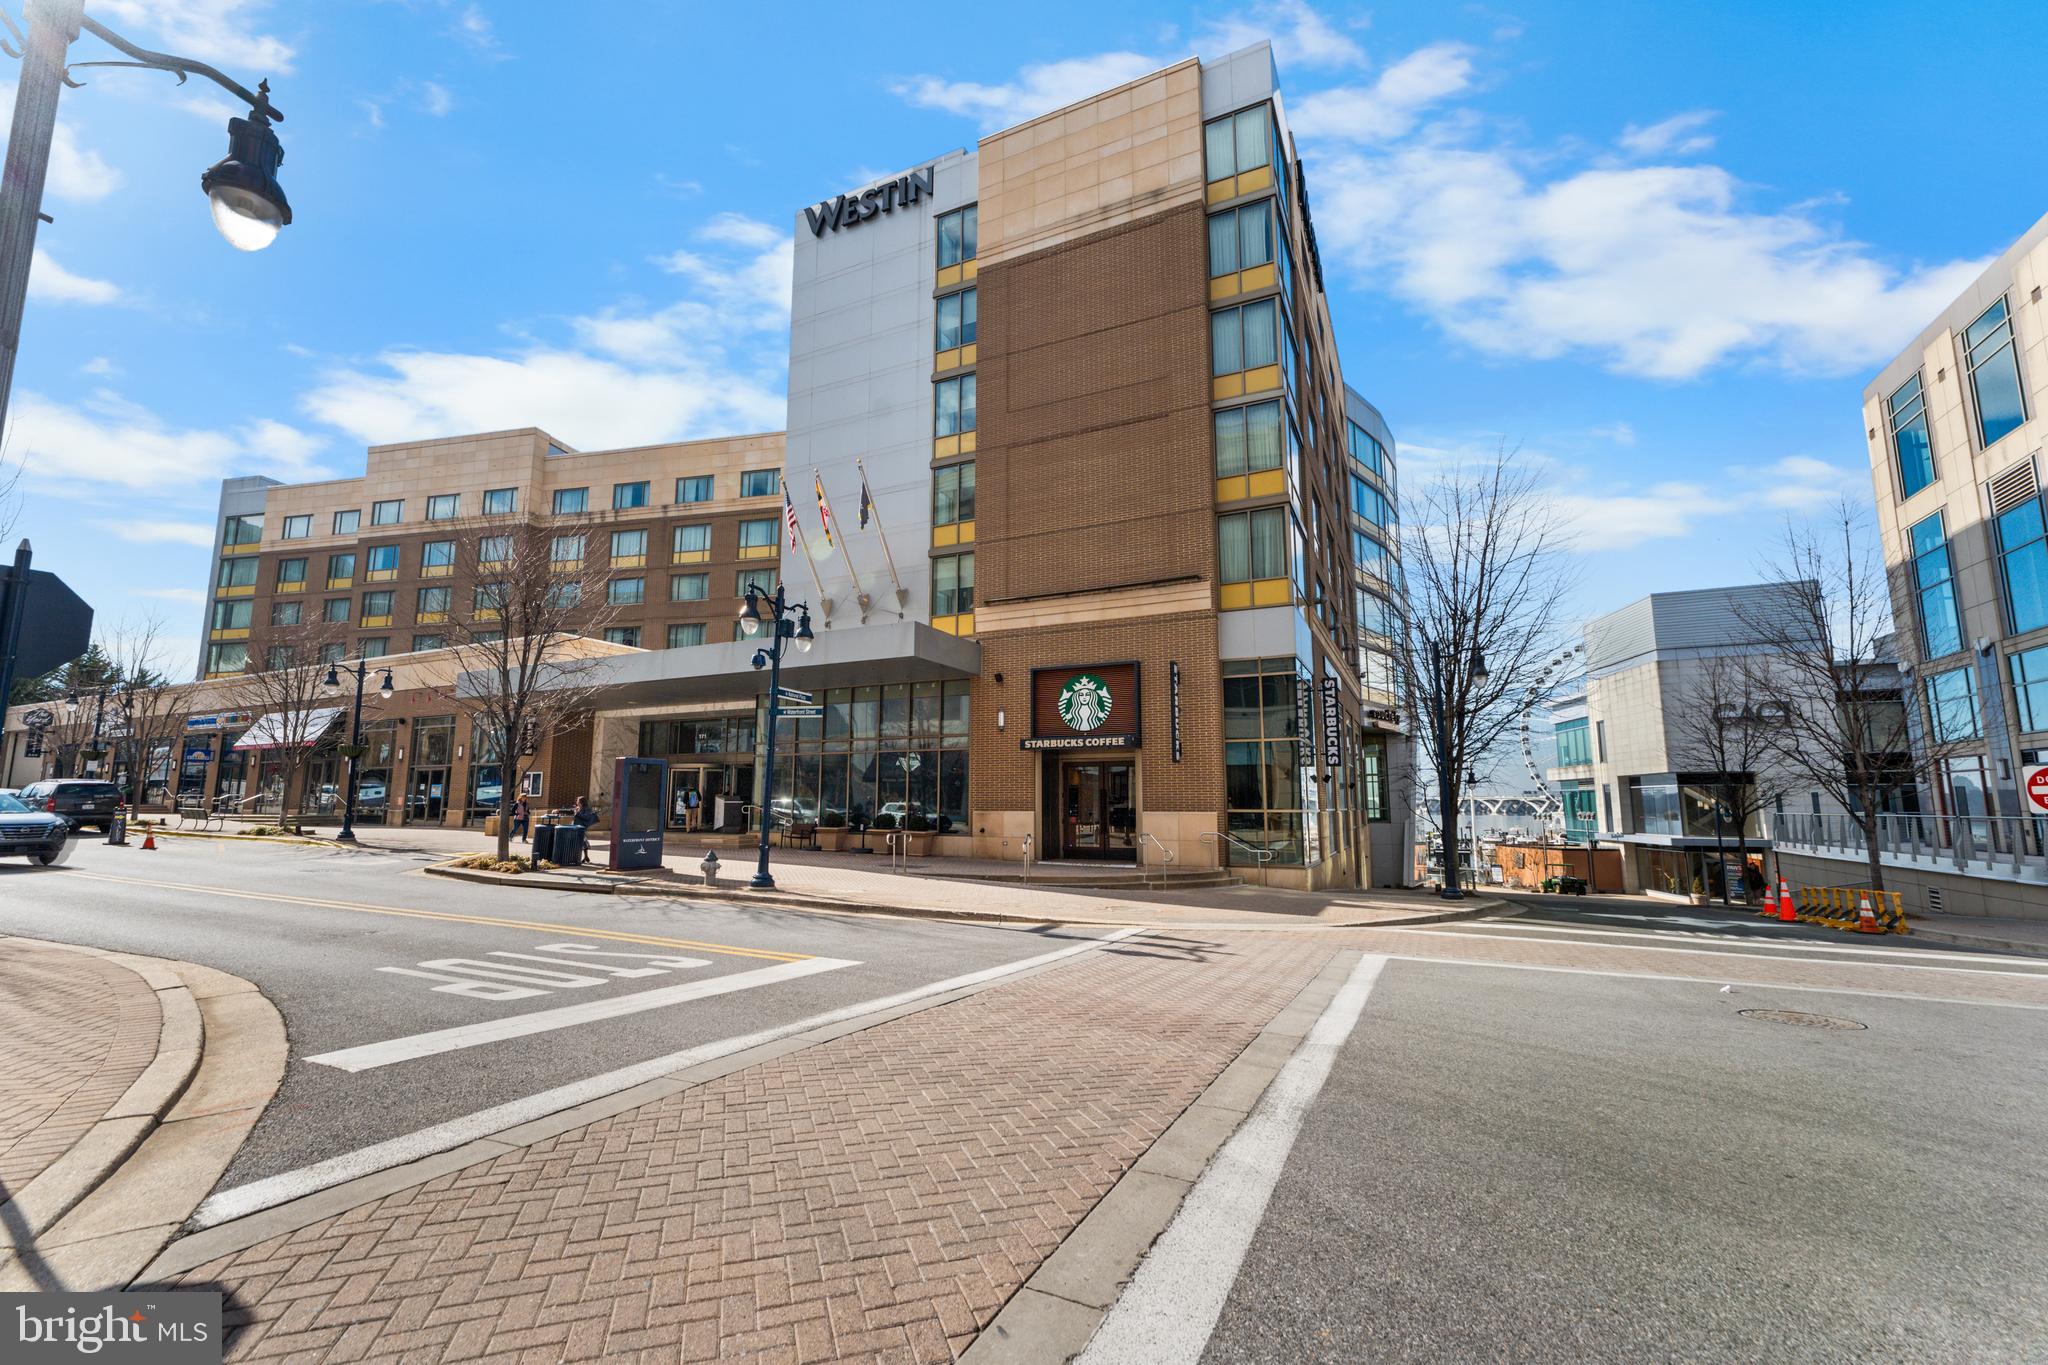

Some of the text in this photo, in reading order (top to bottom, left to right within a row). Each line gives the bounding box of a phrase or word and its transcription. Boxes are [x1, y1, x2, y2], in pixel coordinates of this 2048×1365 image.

[804, 165, 934, 237] WESTIN
[1024, 737, 1125, 748] STARBUCKS COFFEE
[1324, 679, 1339, 765] STARBUCKS
[375, 943, 713, 1001] STOP
